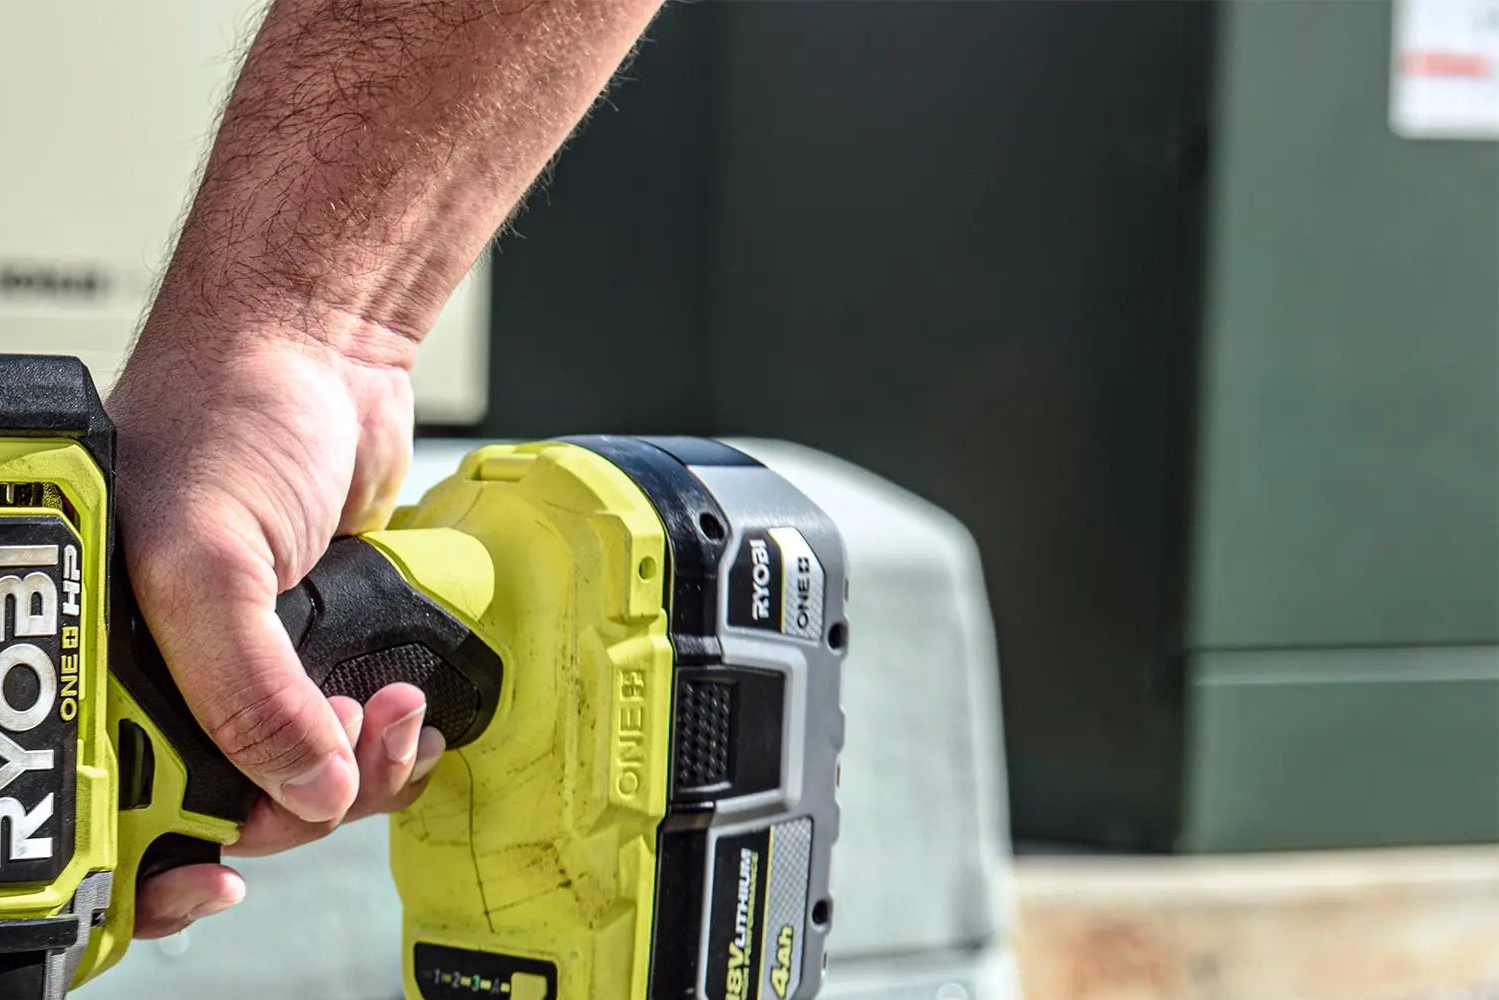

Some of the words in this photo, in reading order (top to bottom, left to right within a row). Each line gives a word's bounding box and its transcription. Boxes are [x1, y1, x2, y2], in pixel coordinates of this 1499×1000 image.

[62, 544, 81, 616] HP
[750, 539, 770, 620] RYOBI
[734, 848, 752, 948] LITHIUM
[771, 926, 793, 998] 4Ah
